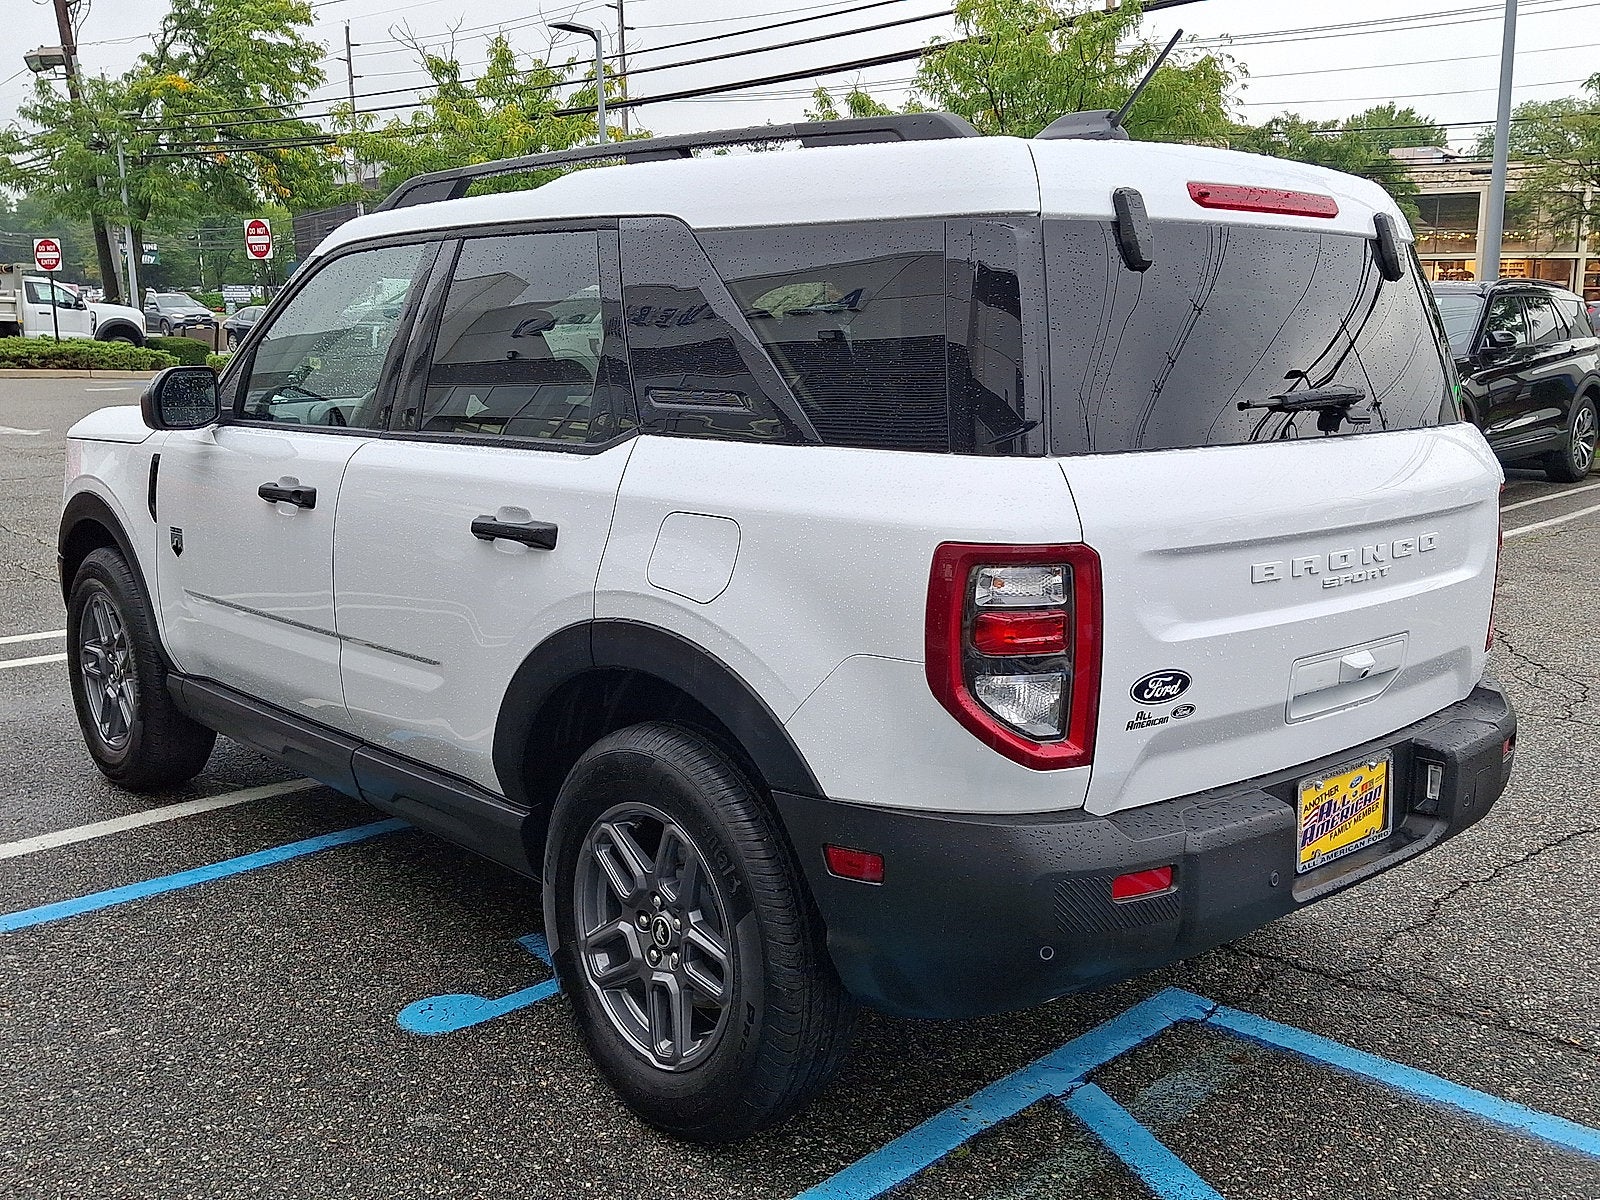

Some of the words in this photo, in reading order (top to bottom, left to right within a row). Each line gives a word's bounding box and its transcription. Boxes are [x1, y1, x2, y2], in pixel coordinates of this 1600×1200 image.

[249, 227, 255, 235] DO
[257, 226, 266, 234] NOT
[252, 244, 267, 252] ENTER
[1251, 531, 1439, 584] BRONCO
[1322, 565, 1392, 588] SPORT
[1143, 675, 1182, 699] Ford
[1125, 716, 1169, 731] AMERICAN
[1135, 710, 1152, 721] ALL
[1303, 785, 1339, 814] ANOTHER
[1319, 793, 1350, 822] ALL
[1301, 785, 1382, 848] AMERICAN
[1329, 820, 1352, 841] FAMILY
[1353, 802, 1380, 826] MEMBER
[1301, 860, 1318, 871] ALL
[1320, 841, 1365, 863] AMERICAN
[1367, 830, 1389, 844] FORD
